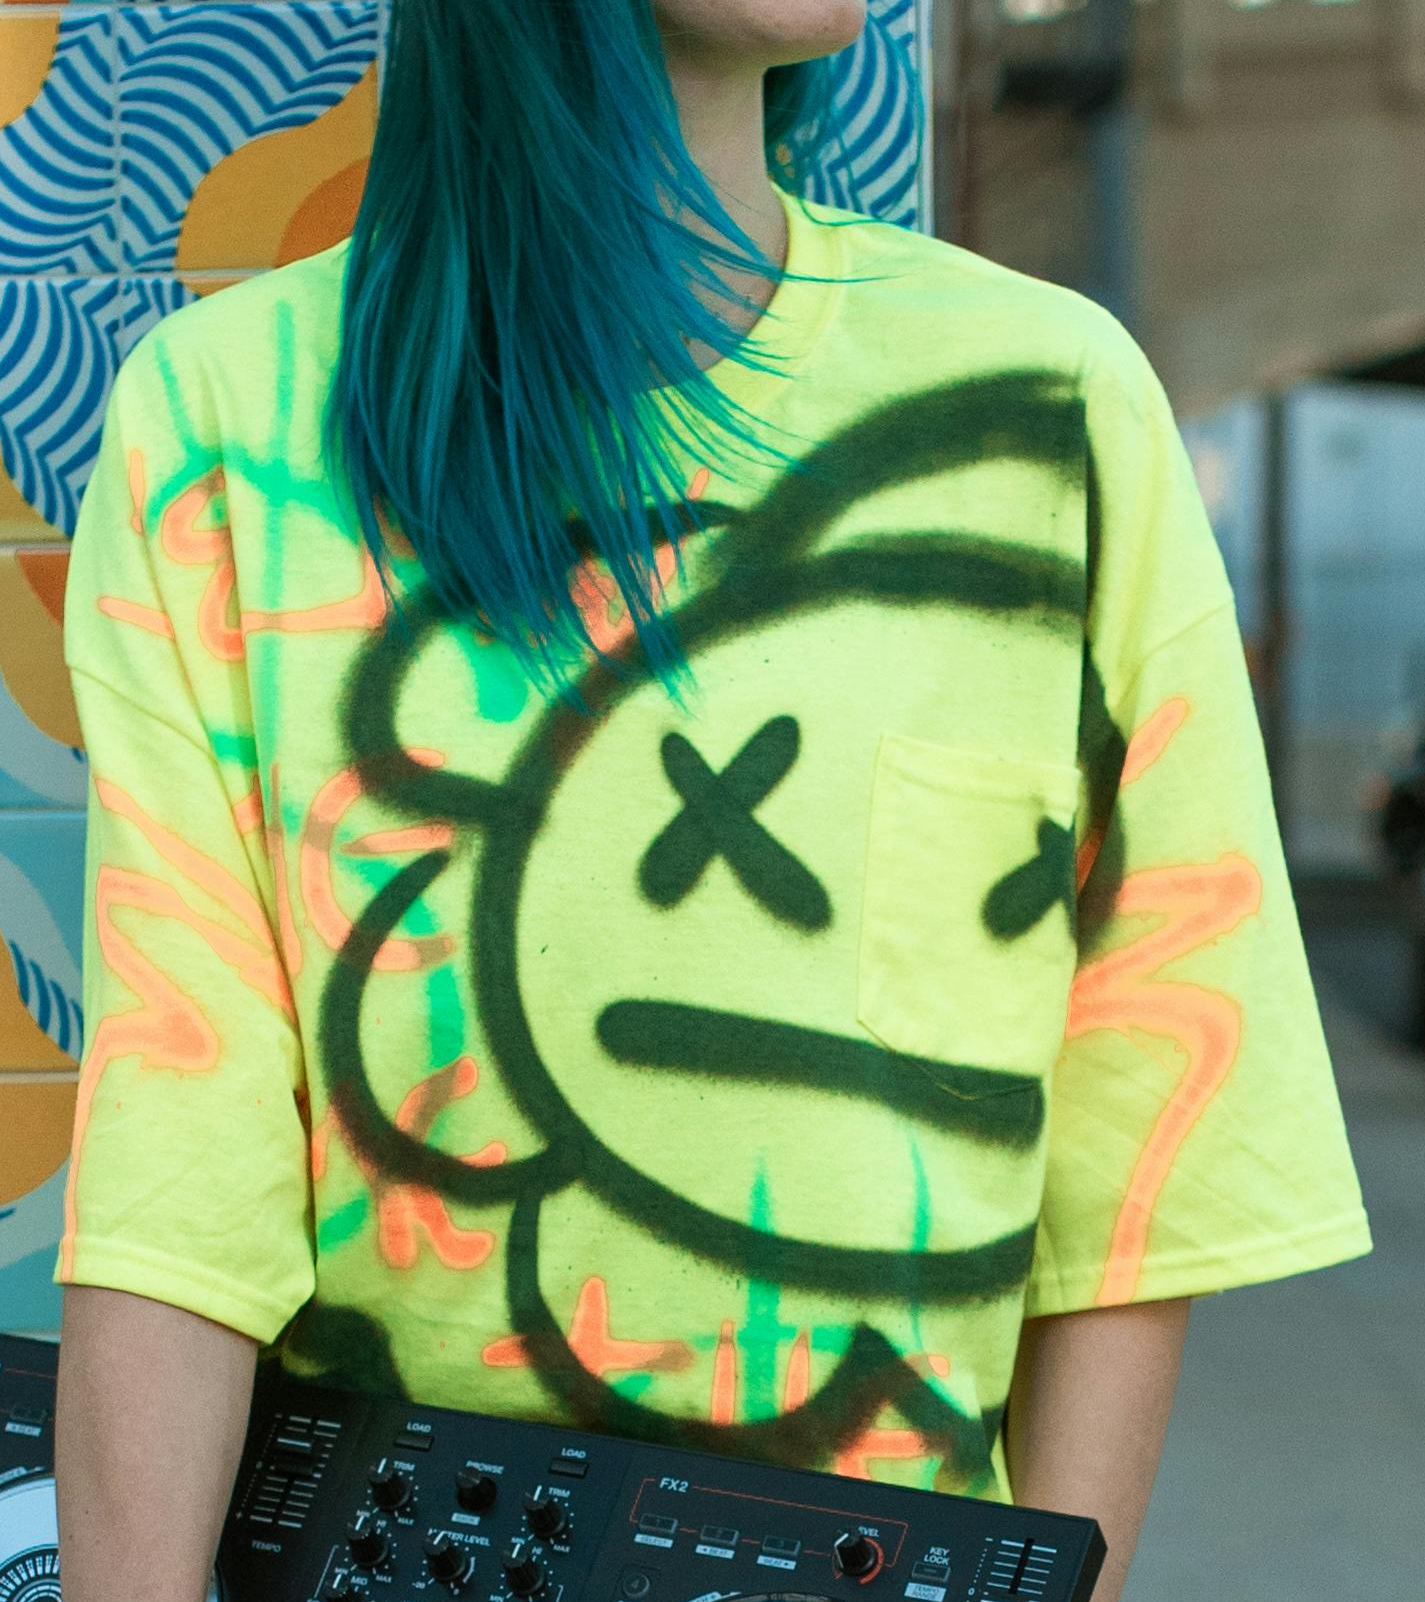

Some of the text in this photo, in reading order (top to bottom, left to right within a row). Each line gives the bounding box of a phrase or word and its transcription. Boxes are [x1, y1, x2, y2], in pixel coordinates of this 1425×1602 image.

[406, 1421, 432, 1433] LOAD
[561, 1448, 586, 1458] LOAD
[393, 1461, 415, 1472] TRIM
[659, 1477, 689, 1493] FX2
[548, 1487, 571, 1498] TRIM
[251, 1540, 282, 1553] TEMPO
[929, 1546, 950, 1557] KEY
[923, 1554, 950, 1566] LOCK
[350, 1576, 368, 1586] MID
